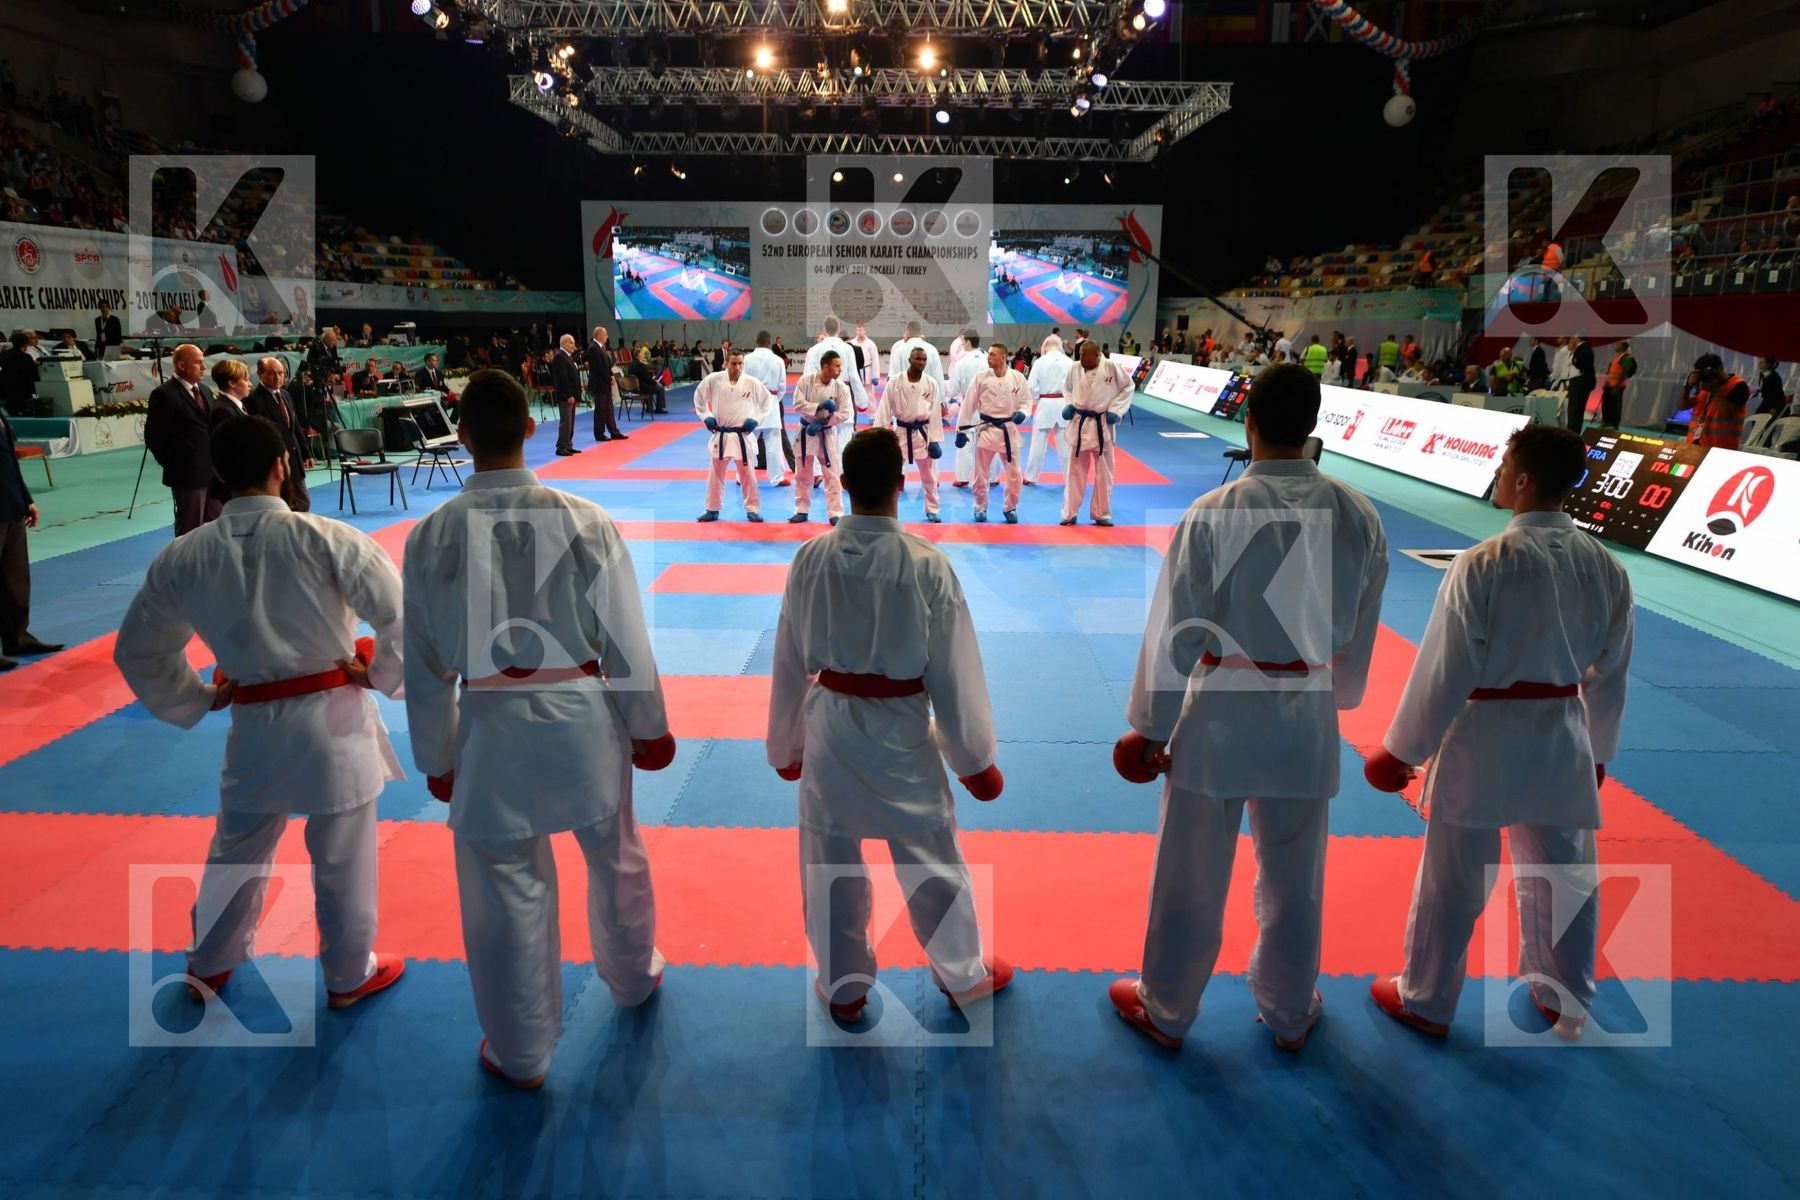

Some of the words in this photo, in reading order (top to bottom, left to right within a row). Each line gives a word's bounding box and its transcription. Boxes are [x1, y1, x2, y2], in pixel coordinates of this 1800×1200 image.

[762, 244, 785, 258] 52ND
[787, 244, 832, 258] EUROPEAN
[836, 245, 867, 258] SENIOR
[870, 245, 903, 259] KARATE
[906, 246, 978, 260] CHAMPIONSHIPS
[835, 264, 850, 274] MAY
[852, 265, 868, 275] 2017
[902, 265, 928, 275] TURKEY
[38, 286, 127, 310] CHAMPIONSHIPS
[136, 290, 158, 310] 2017
[1587, 448, 1607, 461] FRA
[1651, 461, 1671, 474] ITA
[1591, 473, 1634, 499] 3:00
[1639, 484, 1672, 509] 00
[1681, 531, 1736, 560] Kihon
